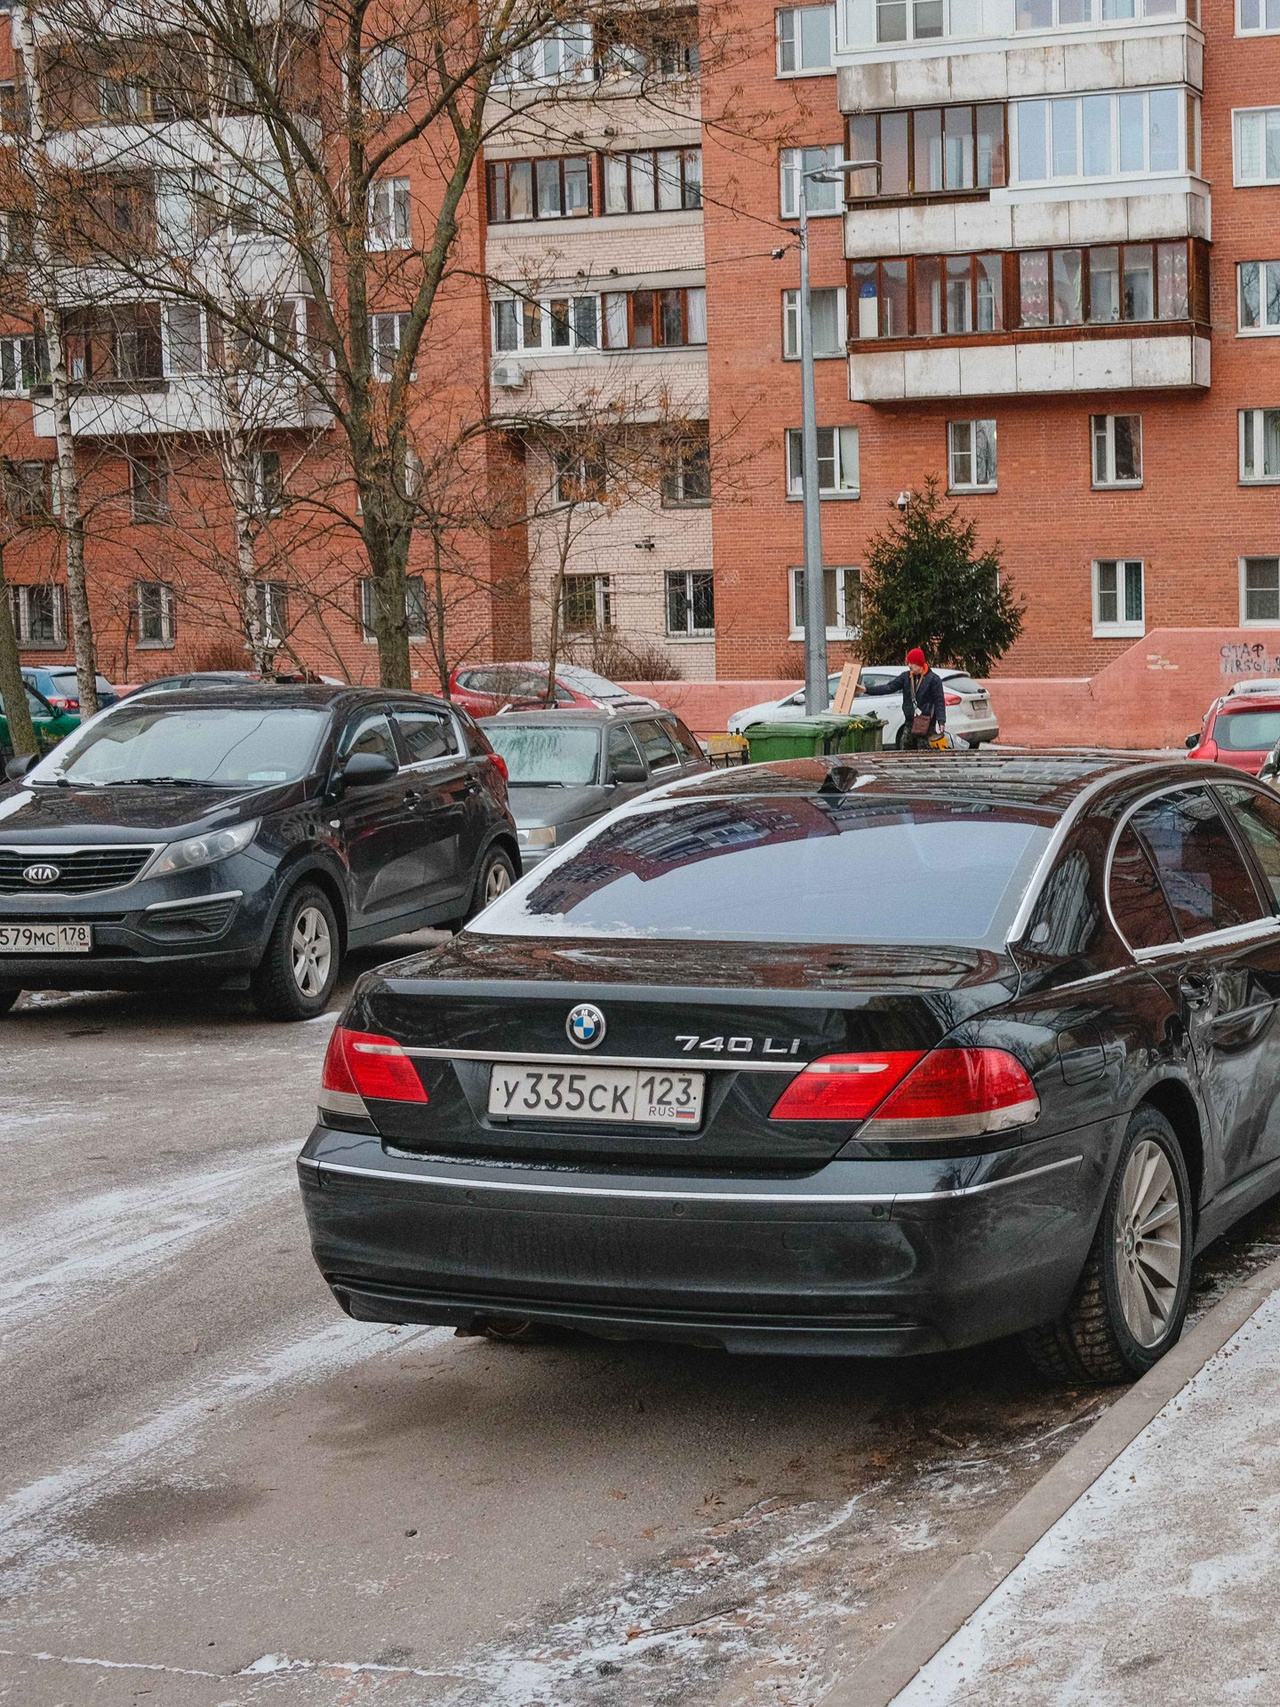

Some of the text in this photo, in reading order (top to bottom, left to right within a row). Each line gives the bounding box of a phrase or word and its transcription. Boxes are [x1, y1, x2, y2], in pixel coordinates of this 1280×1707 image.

[28, 868, 53, 879] KIA
[60, 927, 86, 941] 178
[571, 1009, 599, 1022] BMW
[675, 1035, 801, 1054] 740 Li
[641, 1076, 692, 1106] 123
[649, 1106, 675, 1117] RUS
